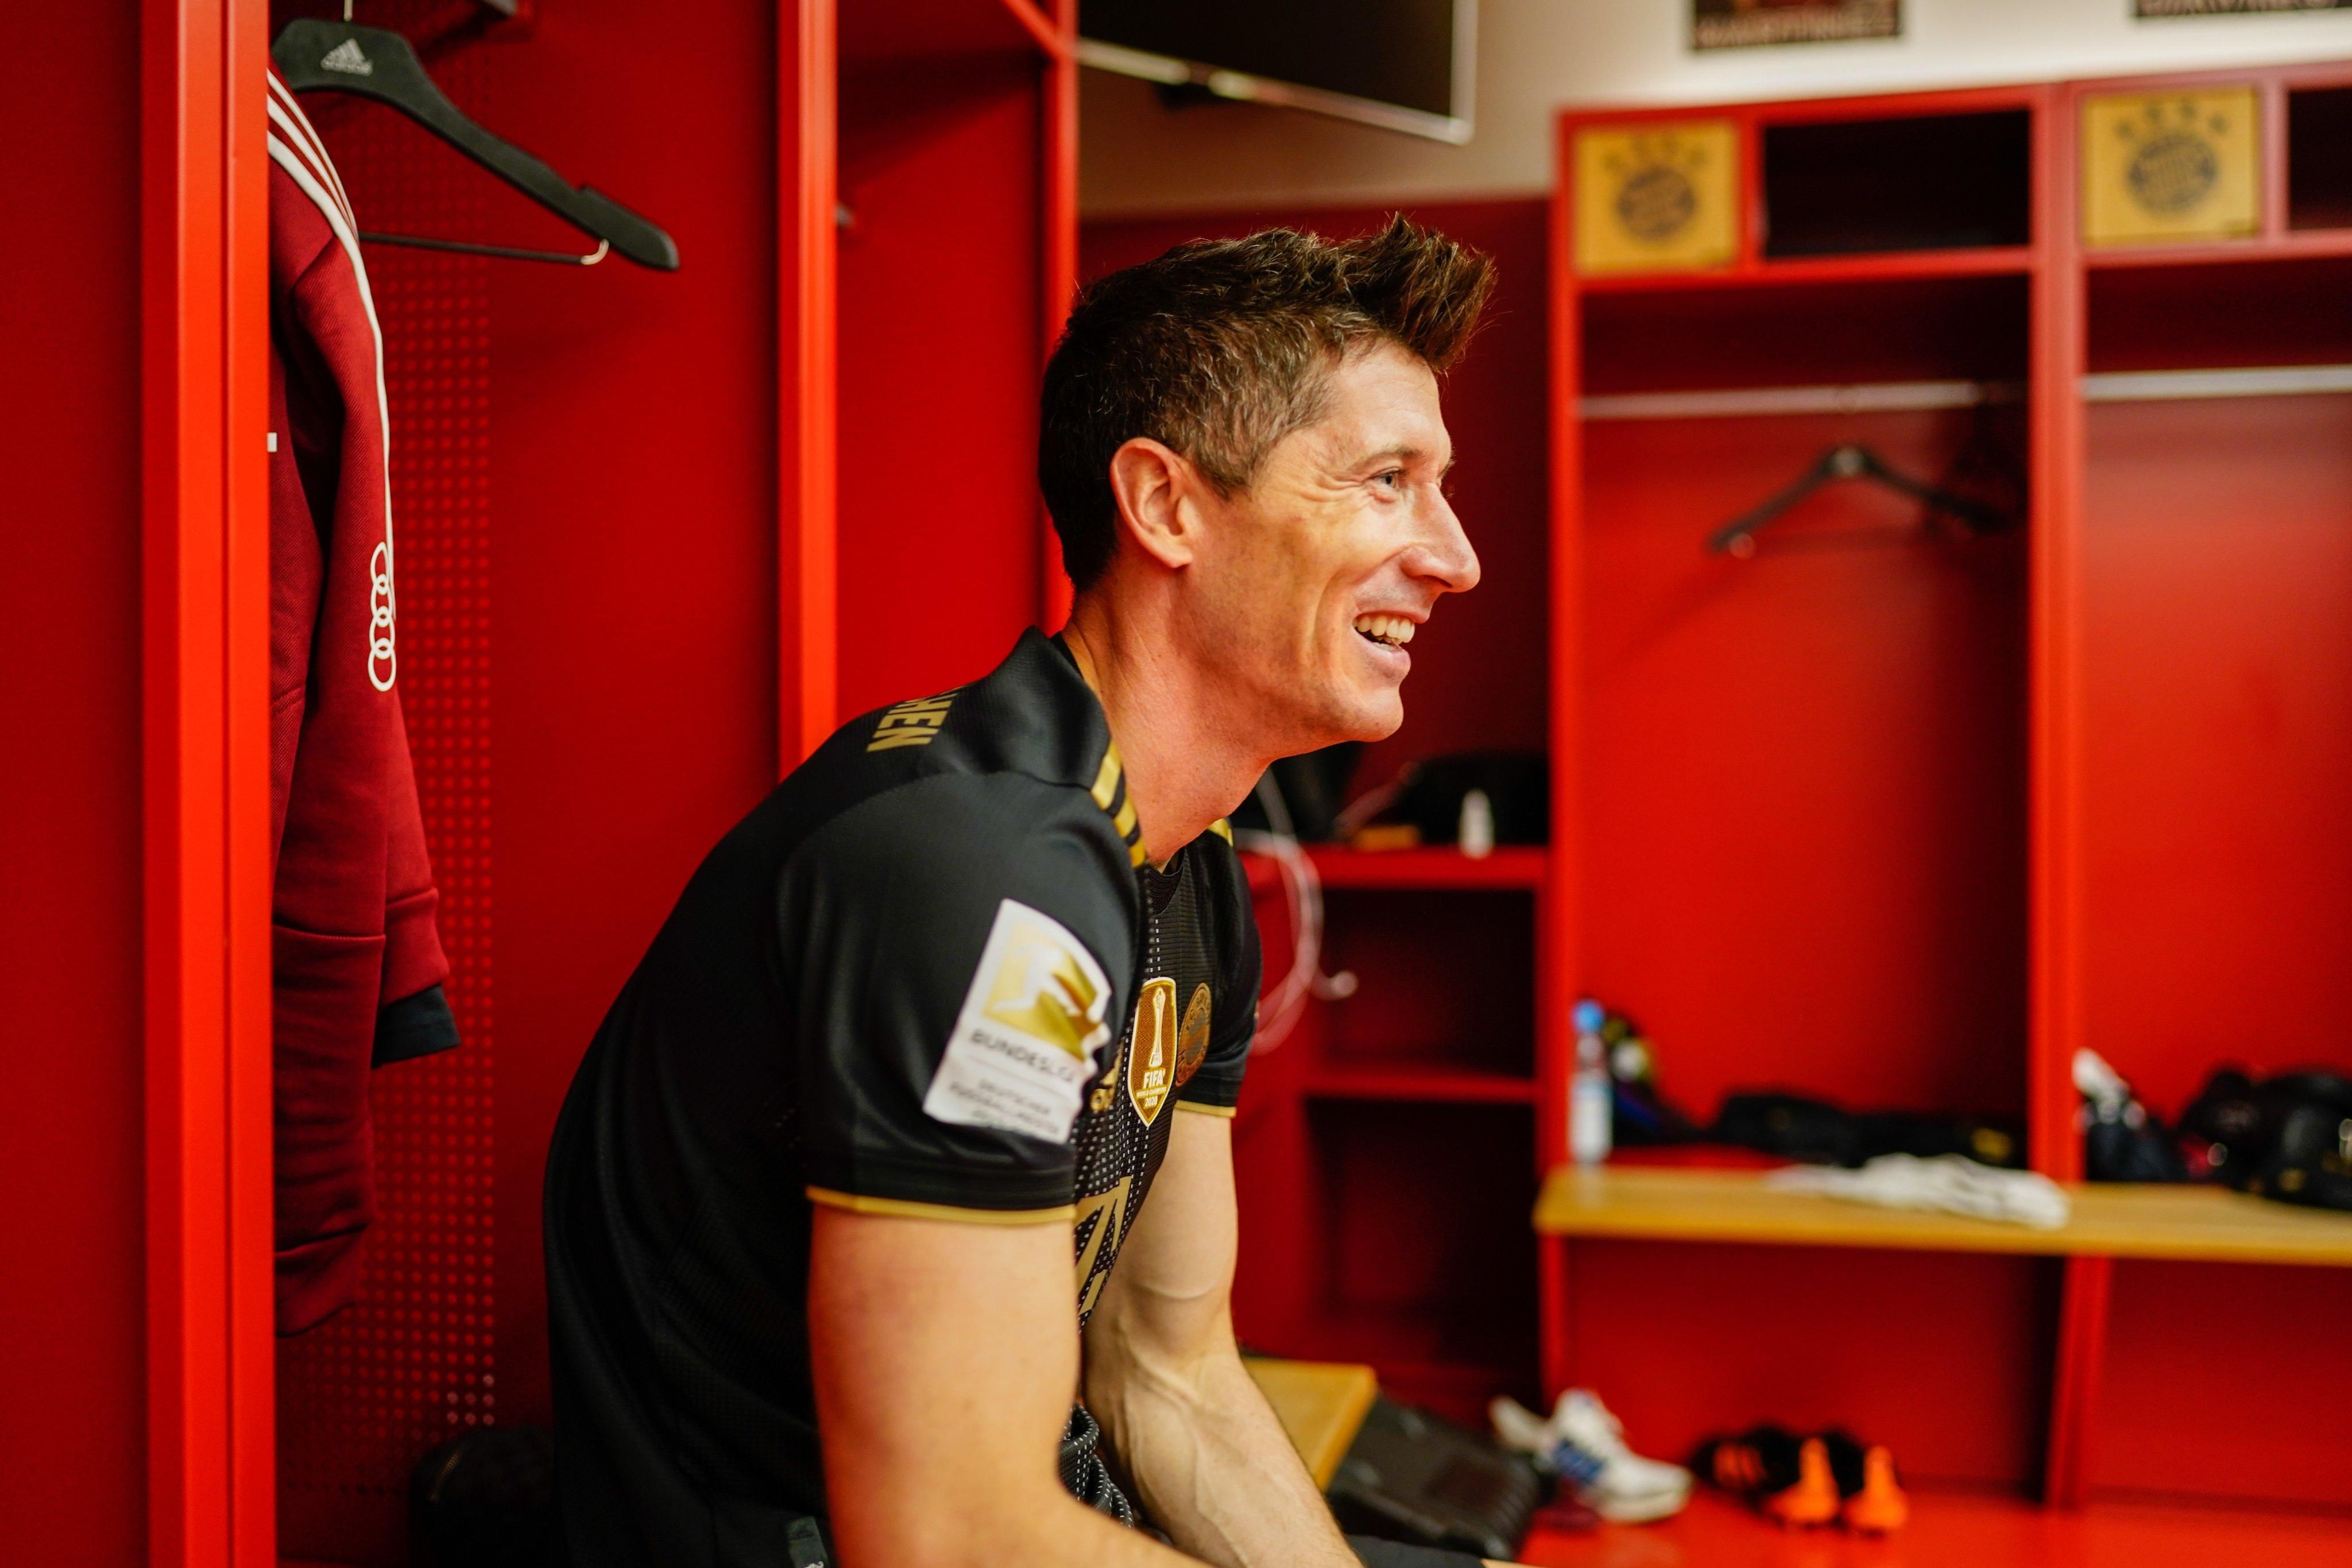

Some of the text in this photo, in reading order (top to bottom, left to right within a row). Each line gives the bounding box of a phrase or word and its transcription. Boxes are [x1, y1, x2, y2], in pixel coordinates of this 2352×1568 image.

[866, 689, 960, 753] HEN
[1143, 1069, 1163, 1089] FIFA
[1144, 1095, 1158, 1108] 2020
